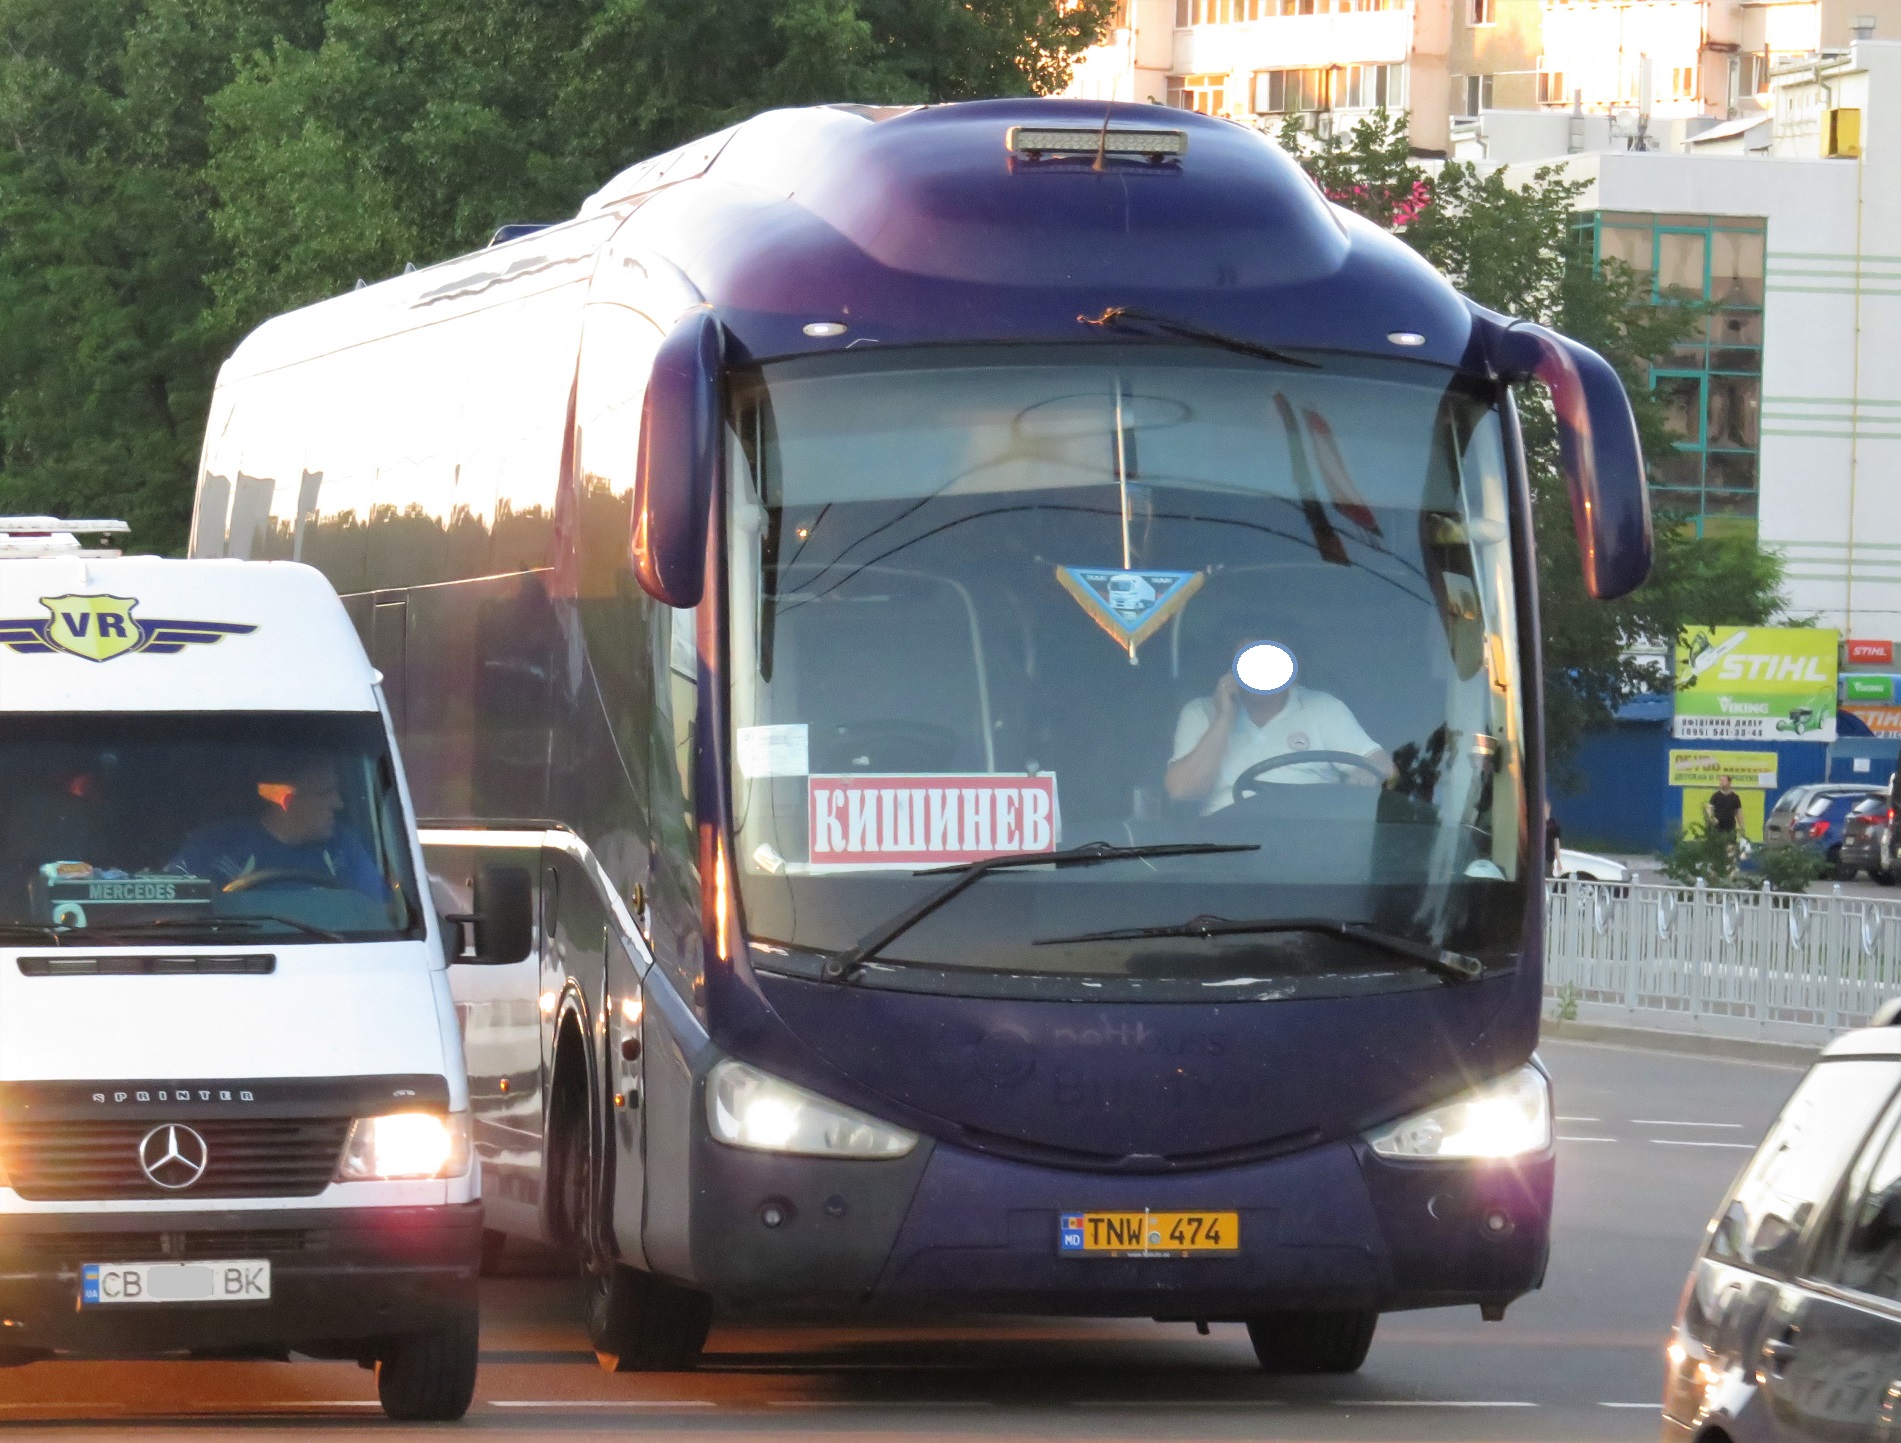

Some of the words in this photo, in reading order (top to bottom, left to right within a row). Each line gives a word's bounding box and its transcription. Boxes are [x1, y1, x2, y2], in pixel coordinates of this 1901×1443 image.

[61, 612, 128, 638] VR
[1852, 646, 1887, 656] STIHL
[1718, 654, 1828, 682] STIHL
[813, 788, 1051, 853] КИШИНЕВ
[89, 884, 176, 899] MERCEDES
[92, 1090, 254, 1104] SPRINTER
[1064, 1234, 1081, 1246] MD
[1088, 1217, 1143, 1246] TNW
[1169, 1217, 1221, 1246] 474
[102, 1271, 142, 1298] CB
[224, 1267, 264, 1295] BK
